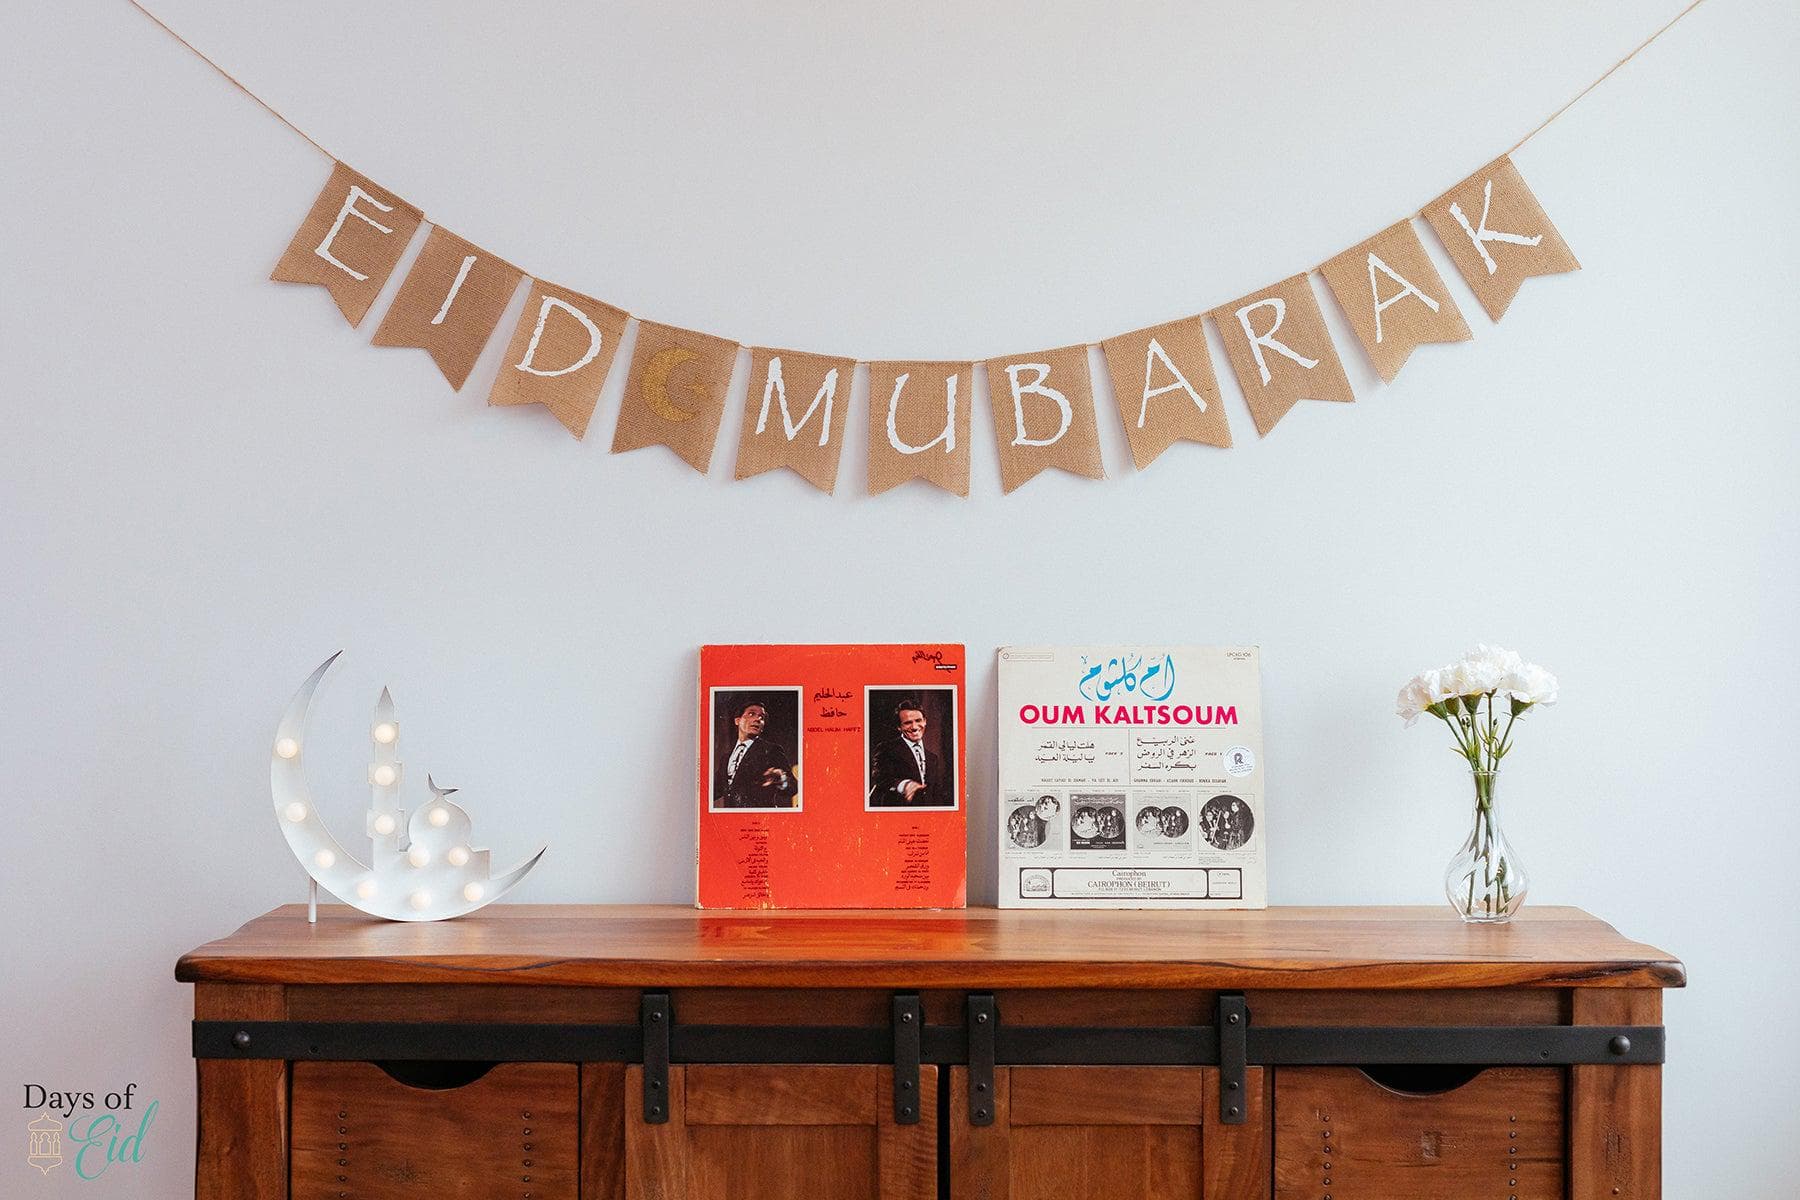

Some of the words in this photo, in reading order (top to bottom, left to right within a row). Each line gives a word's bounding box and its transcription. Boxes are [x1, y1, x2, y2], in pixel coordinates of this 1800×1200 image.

[314, 185, 604, 377] EID
[755, 179, 1544, 455] MUBARAK
[1019, 705, 1085, 725] OUM
[1094, 705, 1239, 725] KALTSOUM
[1087, 880, 1133, 888] CAIROPHON
